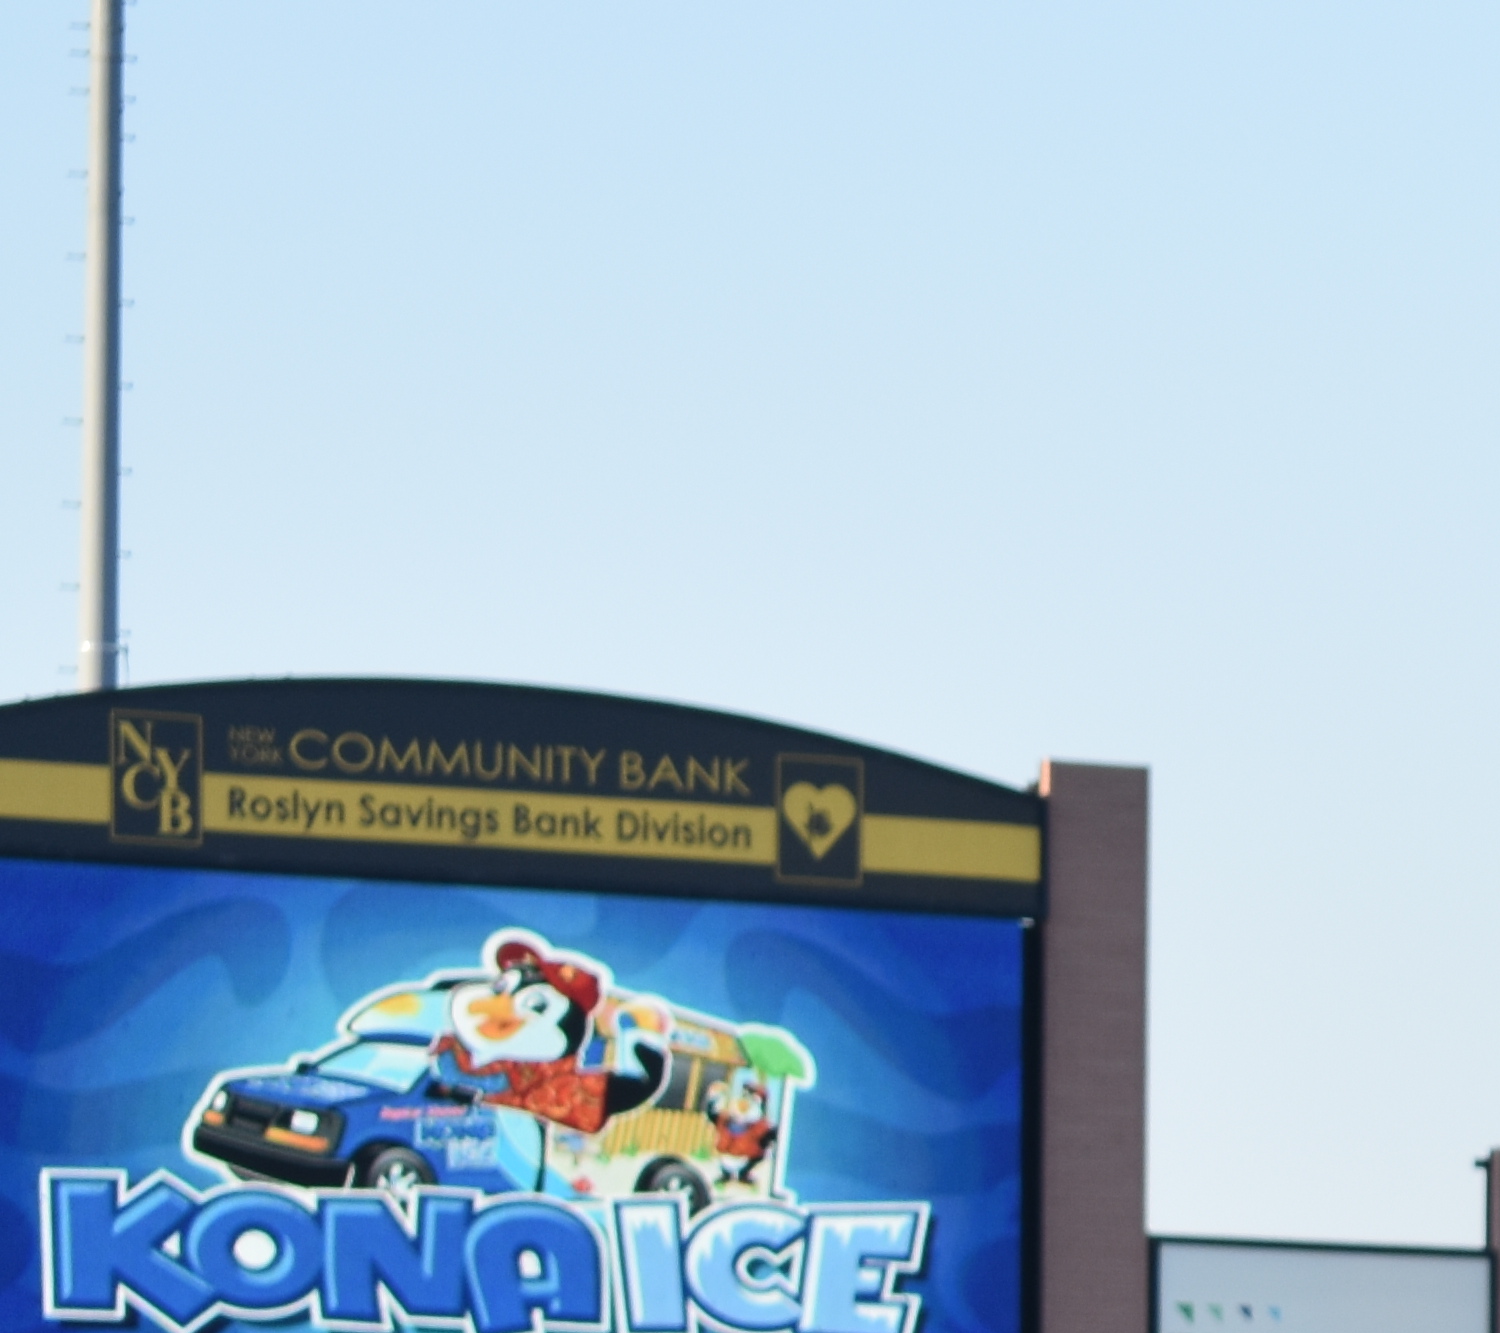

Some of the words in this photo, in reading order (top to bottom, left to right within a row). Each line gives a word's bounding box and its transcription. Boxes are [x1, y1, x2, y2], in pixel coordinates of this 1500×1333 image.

[289, 727, 607, 787] COMMUNITY
[618, 749, 751, 796] BANK
[227, 786, 346, 829] Roslyn
[358, 793, 500, 840] Savings
[513, 803, 603, 840] Bank
[615, 808, 753, 850] Division
